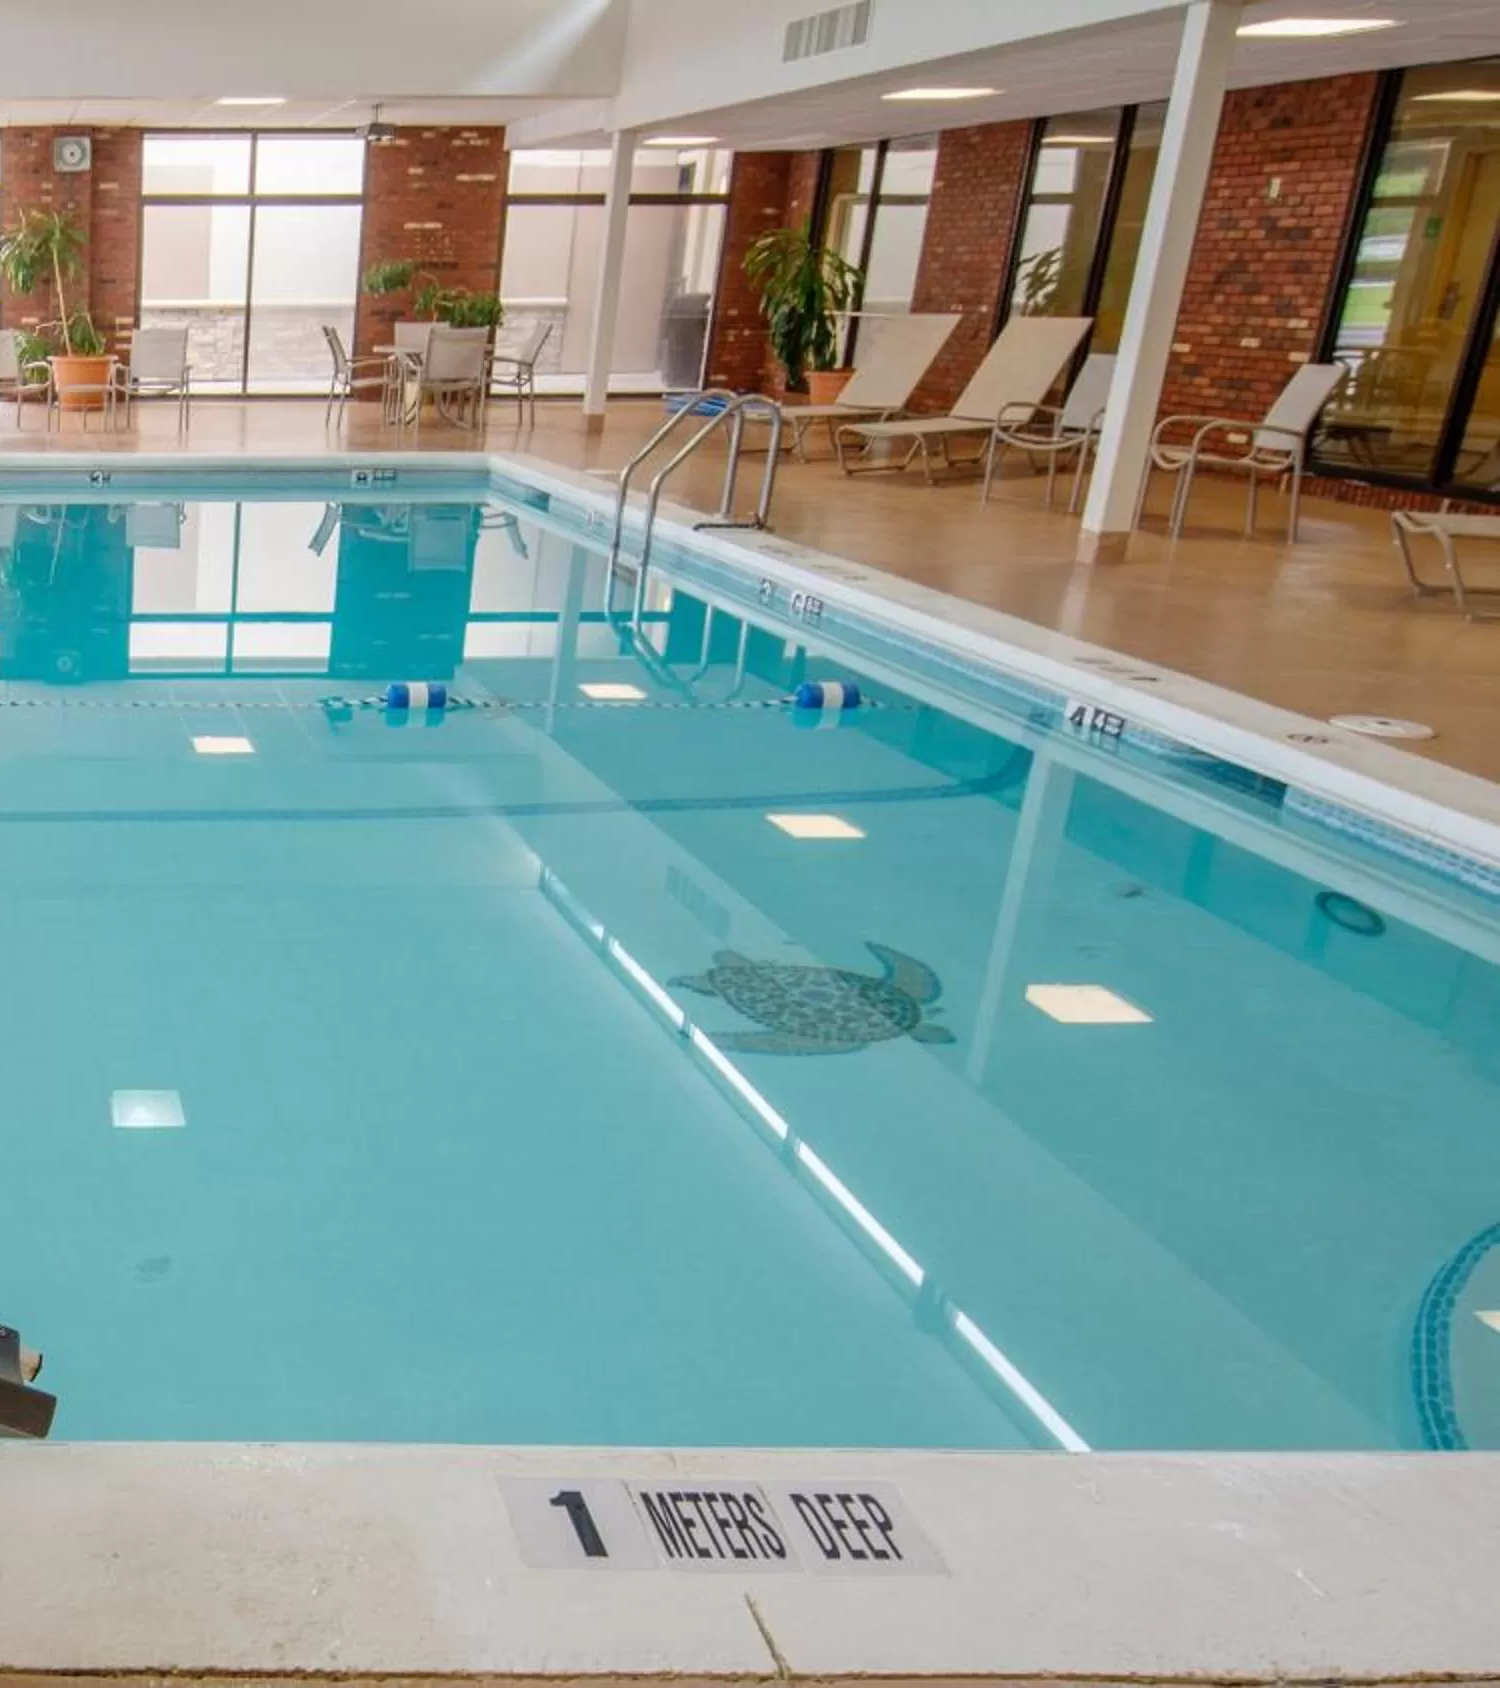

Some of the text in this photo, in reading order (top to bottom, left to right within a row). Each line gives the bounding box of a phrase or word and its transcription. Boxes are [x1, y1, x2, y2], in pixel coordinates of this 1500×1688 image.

[1069, 706, 1087, 727] 4
[549, 1489, 904, 1561] 1 METERS DEEP
